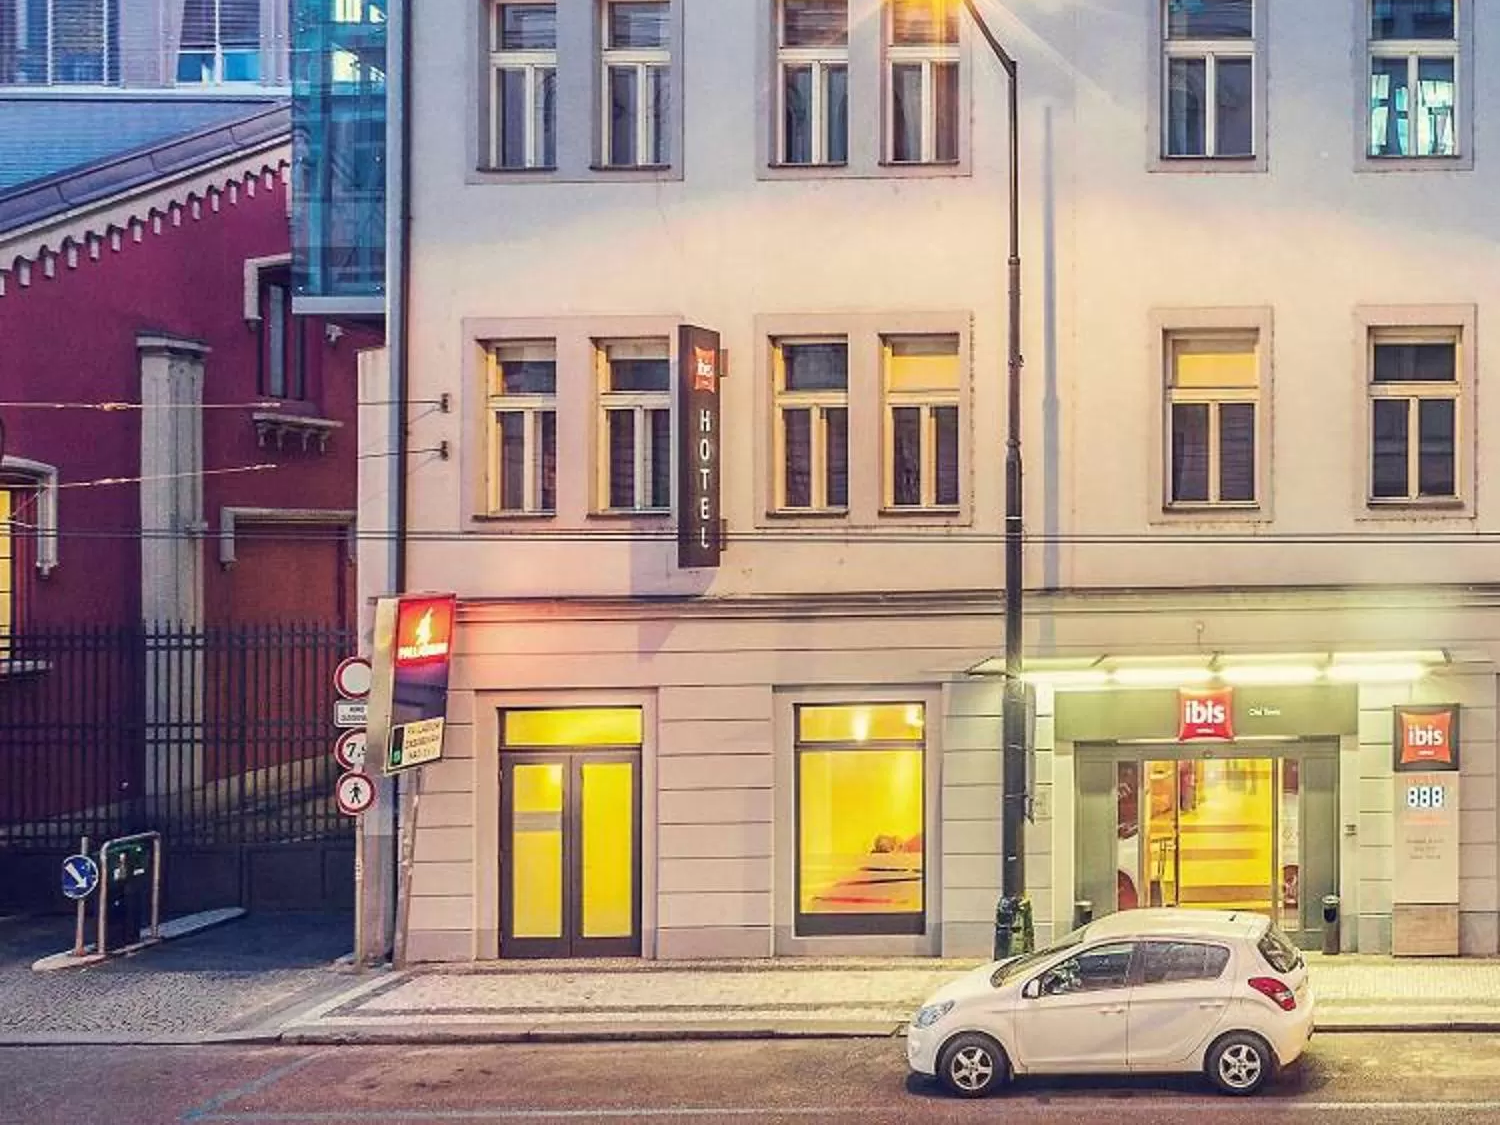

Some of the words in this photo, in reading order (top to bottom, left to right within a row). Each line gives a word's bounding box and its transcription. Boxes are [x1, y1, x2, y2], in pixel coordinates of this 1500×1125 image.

[699, 409, 711, 549] HOTEL
[1185, 700, 1225, 724] ibis
[1408, 725, 1444, 746] ibis
